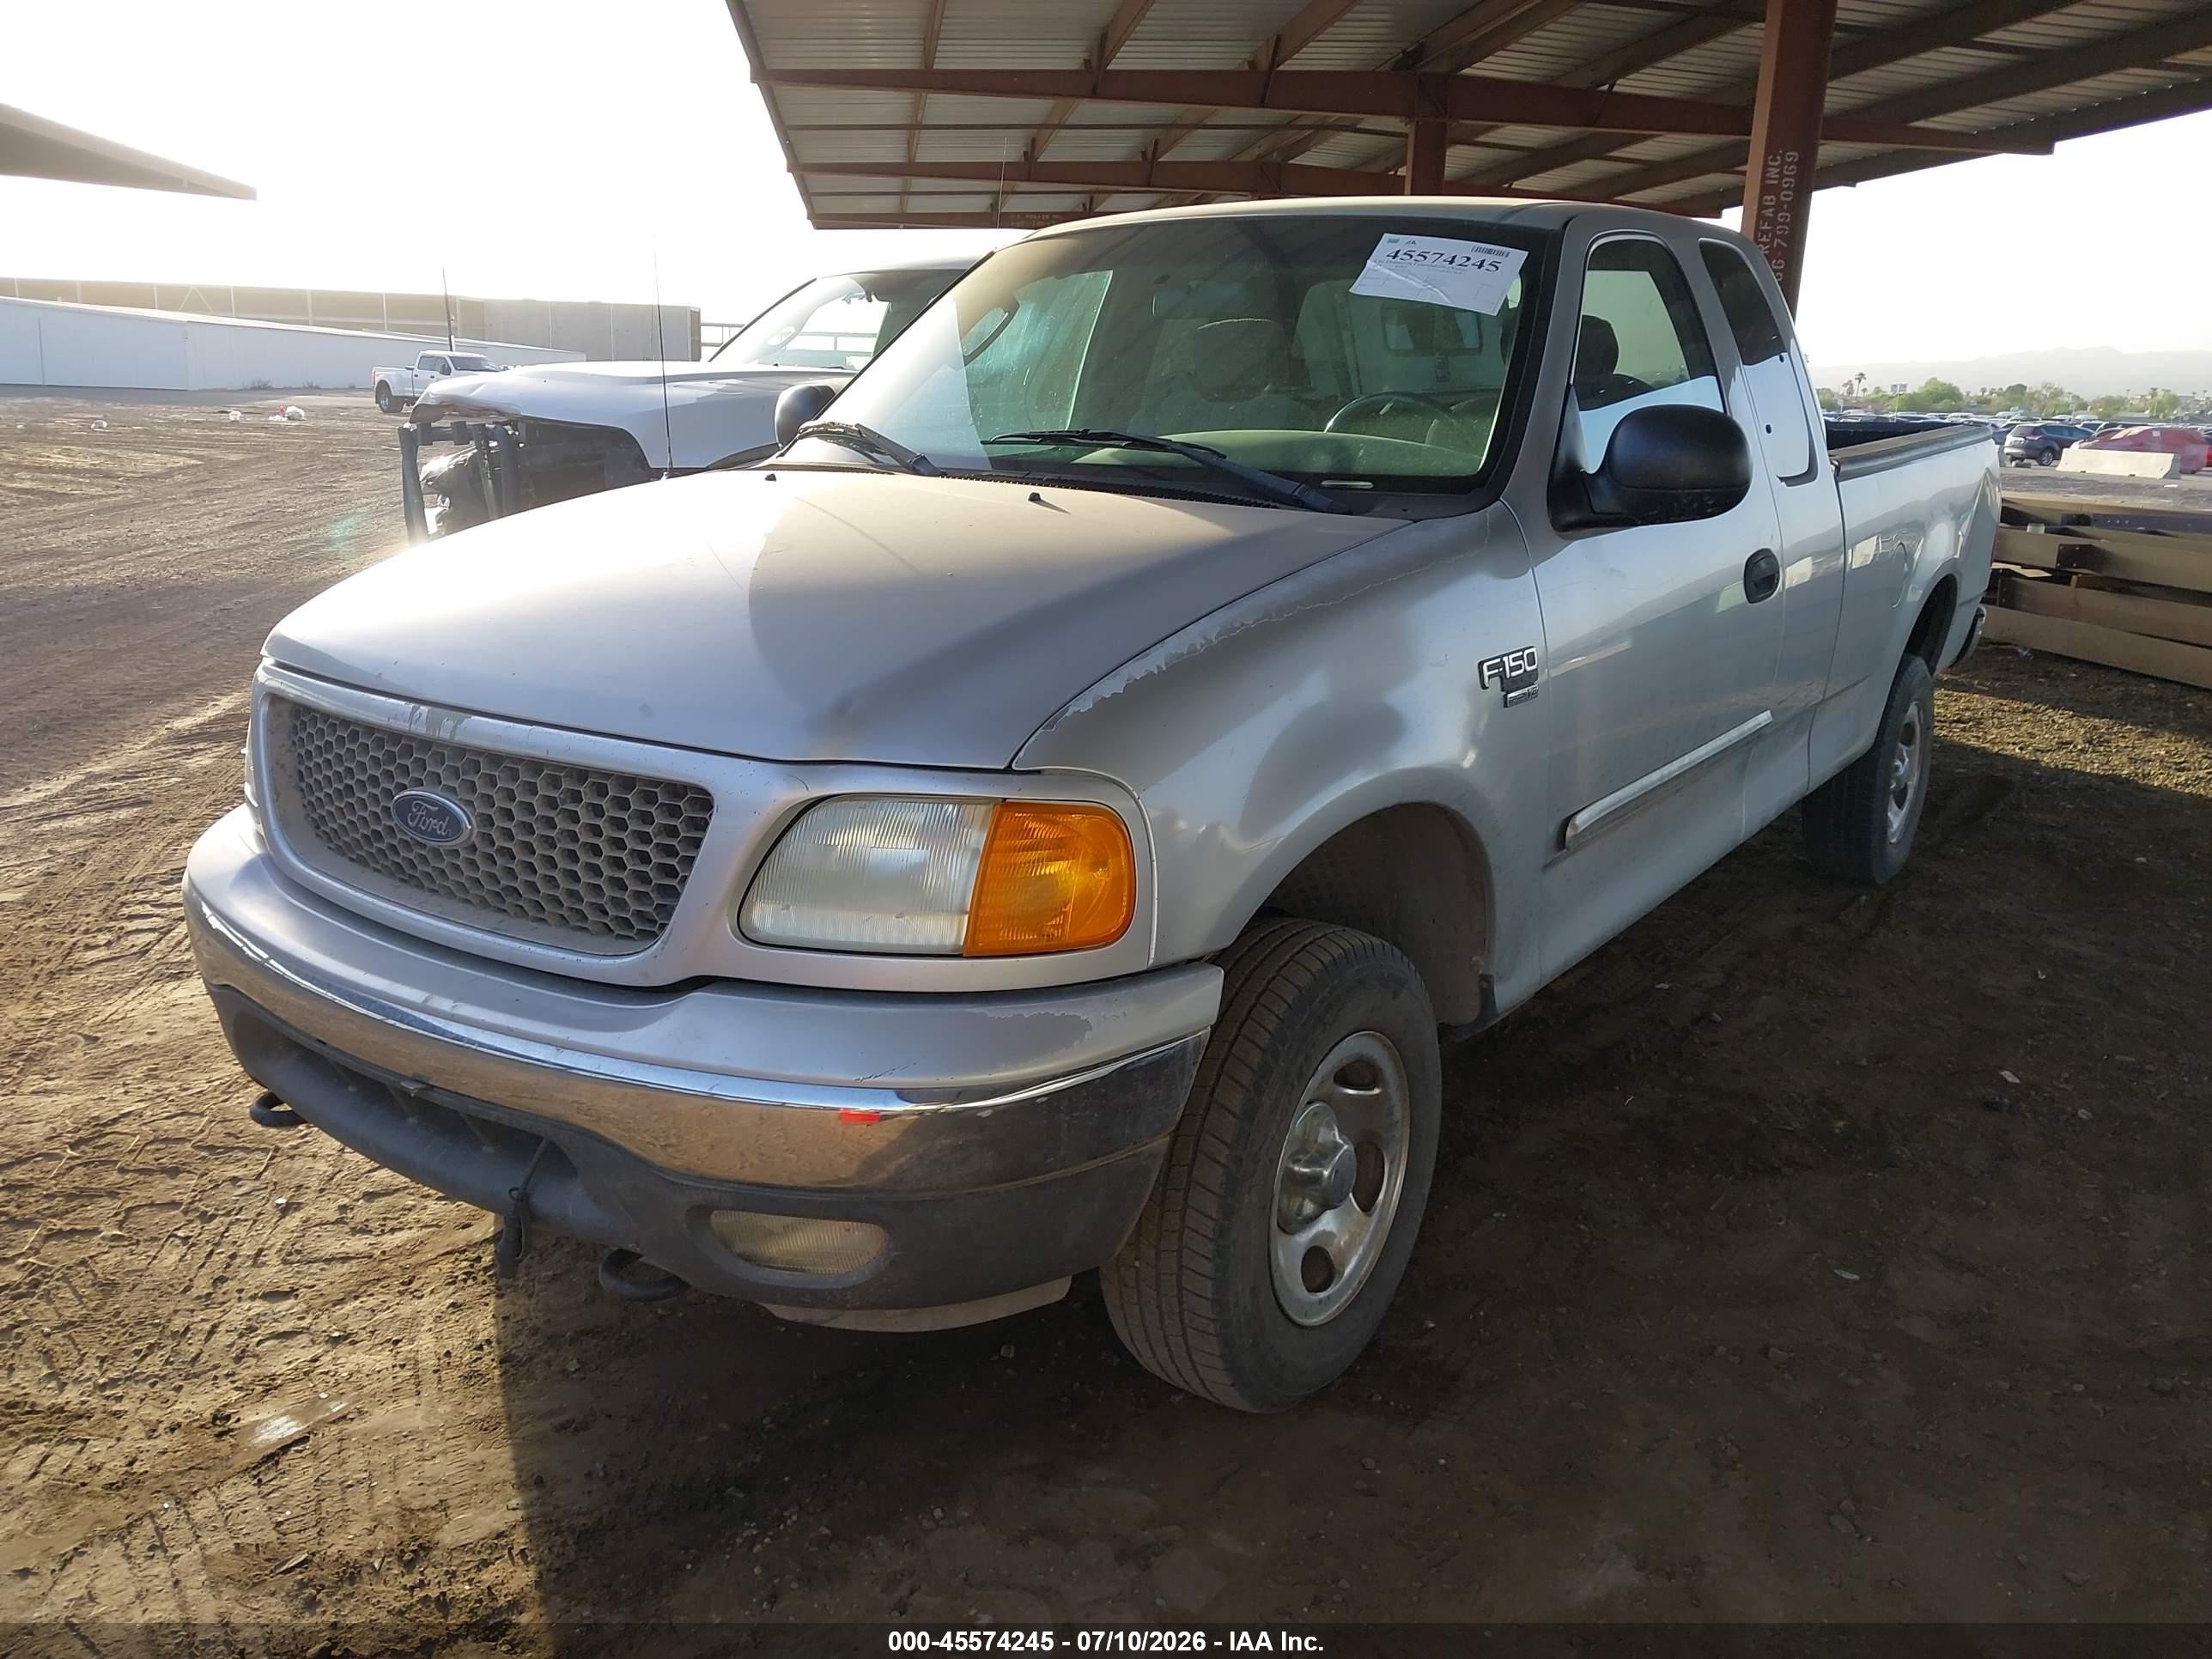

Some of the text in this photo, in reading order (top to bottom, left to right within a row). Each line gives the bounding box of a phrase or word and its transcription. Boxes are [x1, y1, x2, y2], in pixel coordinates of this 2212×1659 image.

[1765, 149, 1784, 185] INC.
[1385, 248, 1502, 273] 45574245
[1482, 647, 1538, 688] F-150
[407, 800, 449, 836] Ford
